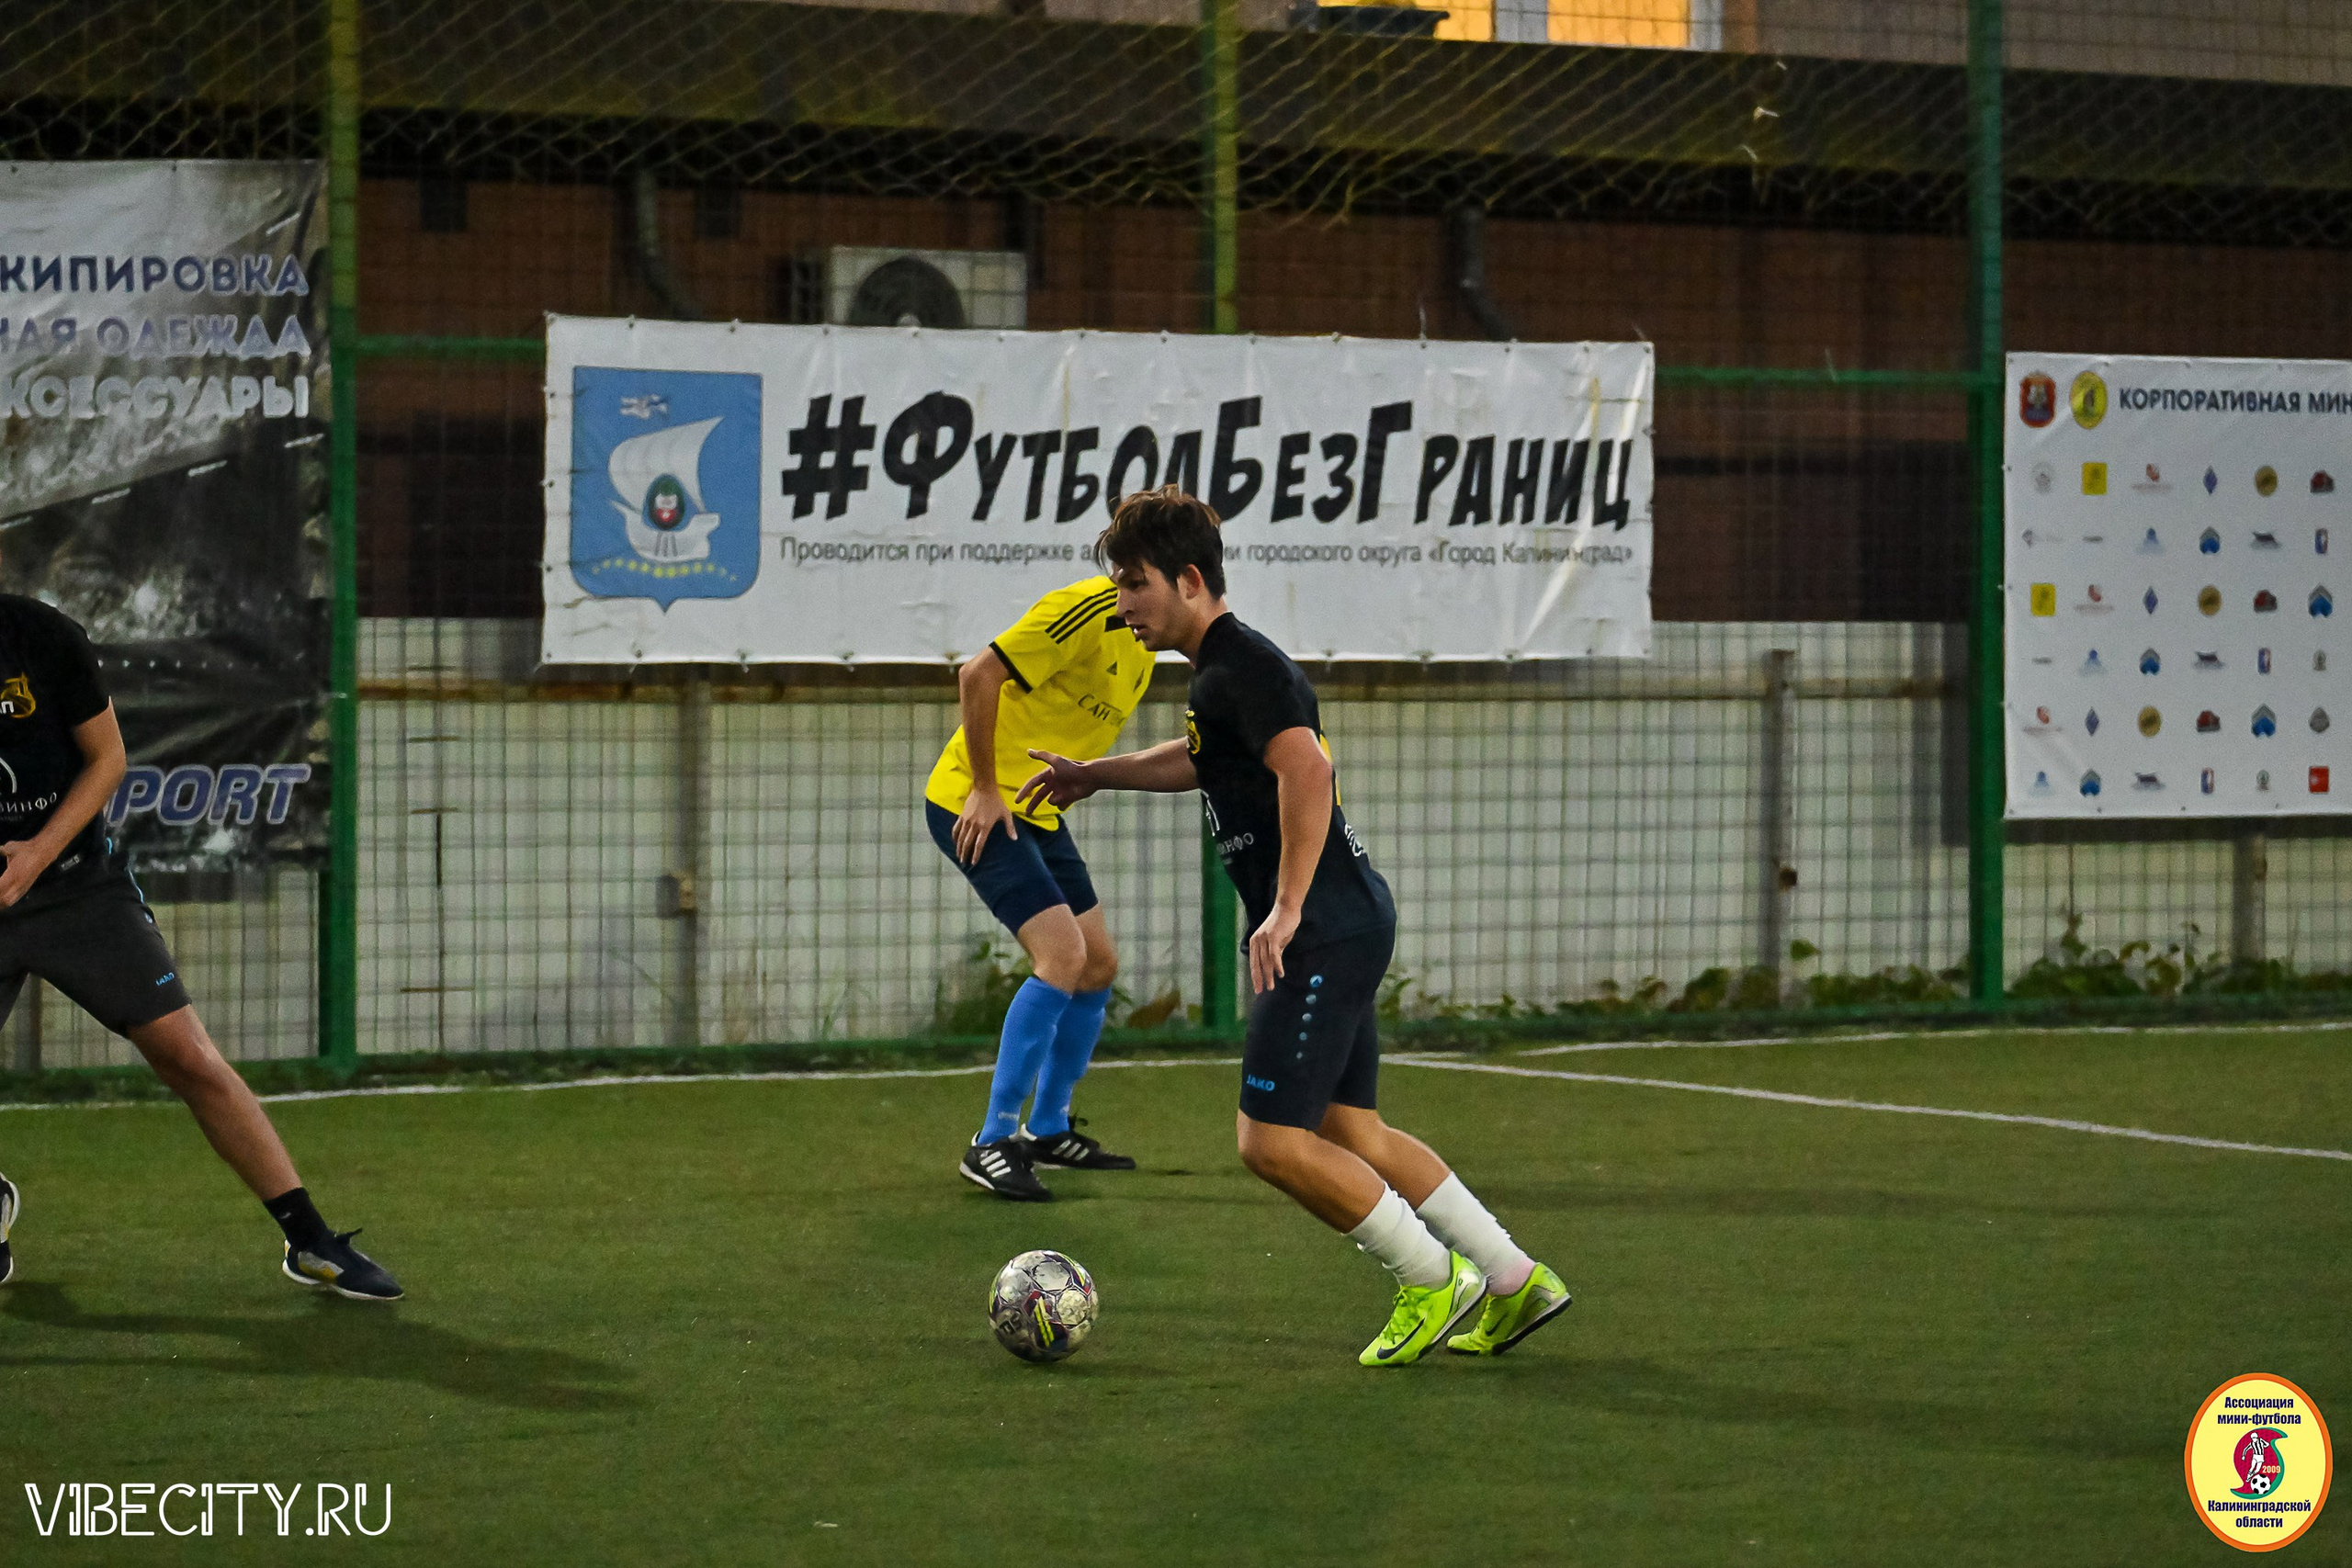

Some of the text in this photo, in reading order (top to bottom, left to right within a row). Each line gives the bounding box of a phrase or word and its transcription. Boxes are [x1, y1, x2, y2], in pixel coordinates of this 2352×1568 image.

[0, 254, 310, 296] КИПИРОВКА
[96, 314, 311, 361] ОДЕЖДА
[2120, 388, 2301, 413] КОРПОРАТИВНАЯ
[781, 536, 909, 567] Проводится
[915, 543, 955, 565] при
[961, 543, 1073, 566] поддержке
[1248, 544, 1352, 566] городского
[1358, 544, 1422, 567] округа
[1429, 537, 1496, 567] «Город
[107, 763, 311, 827] PORT
